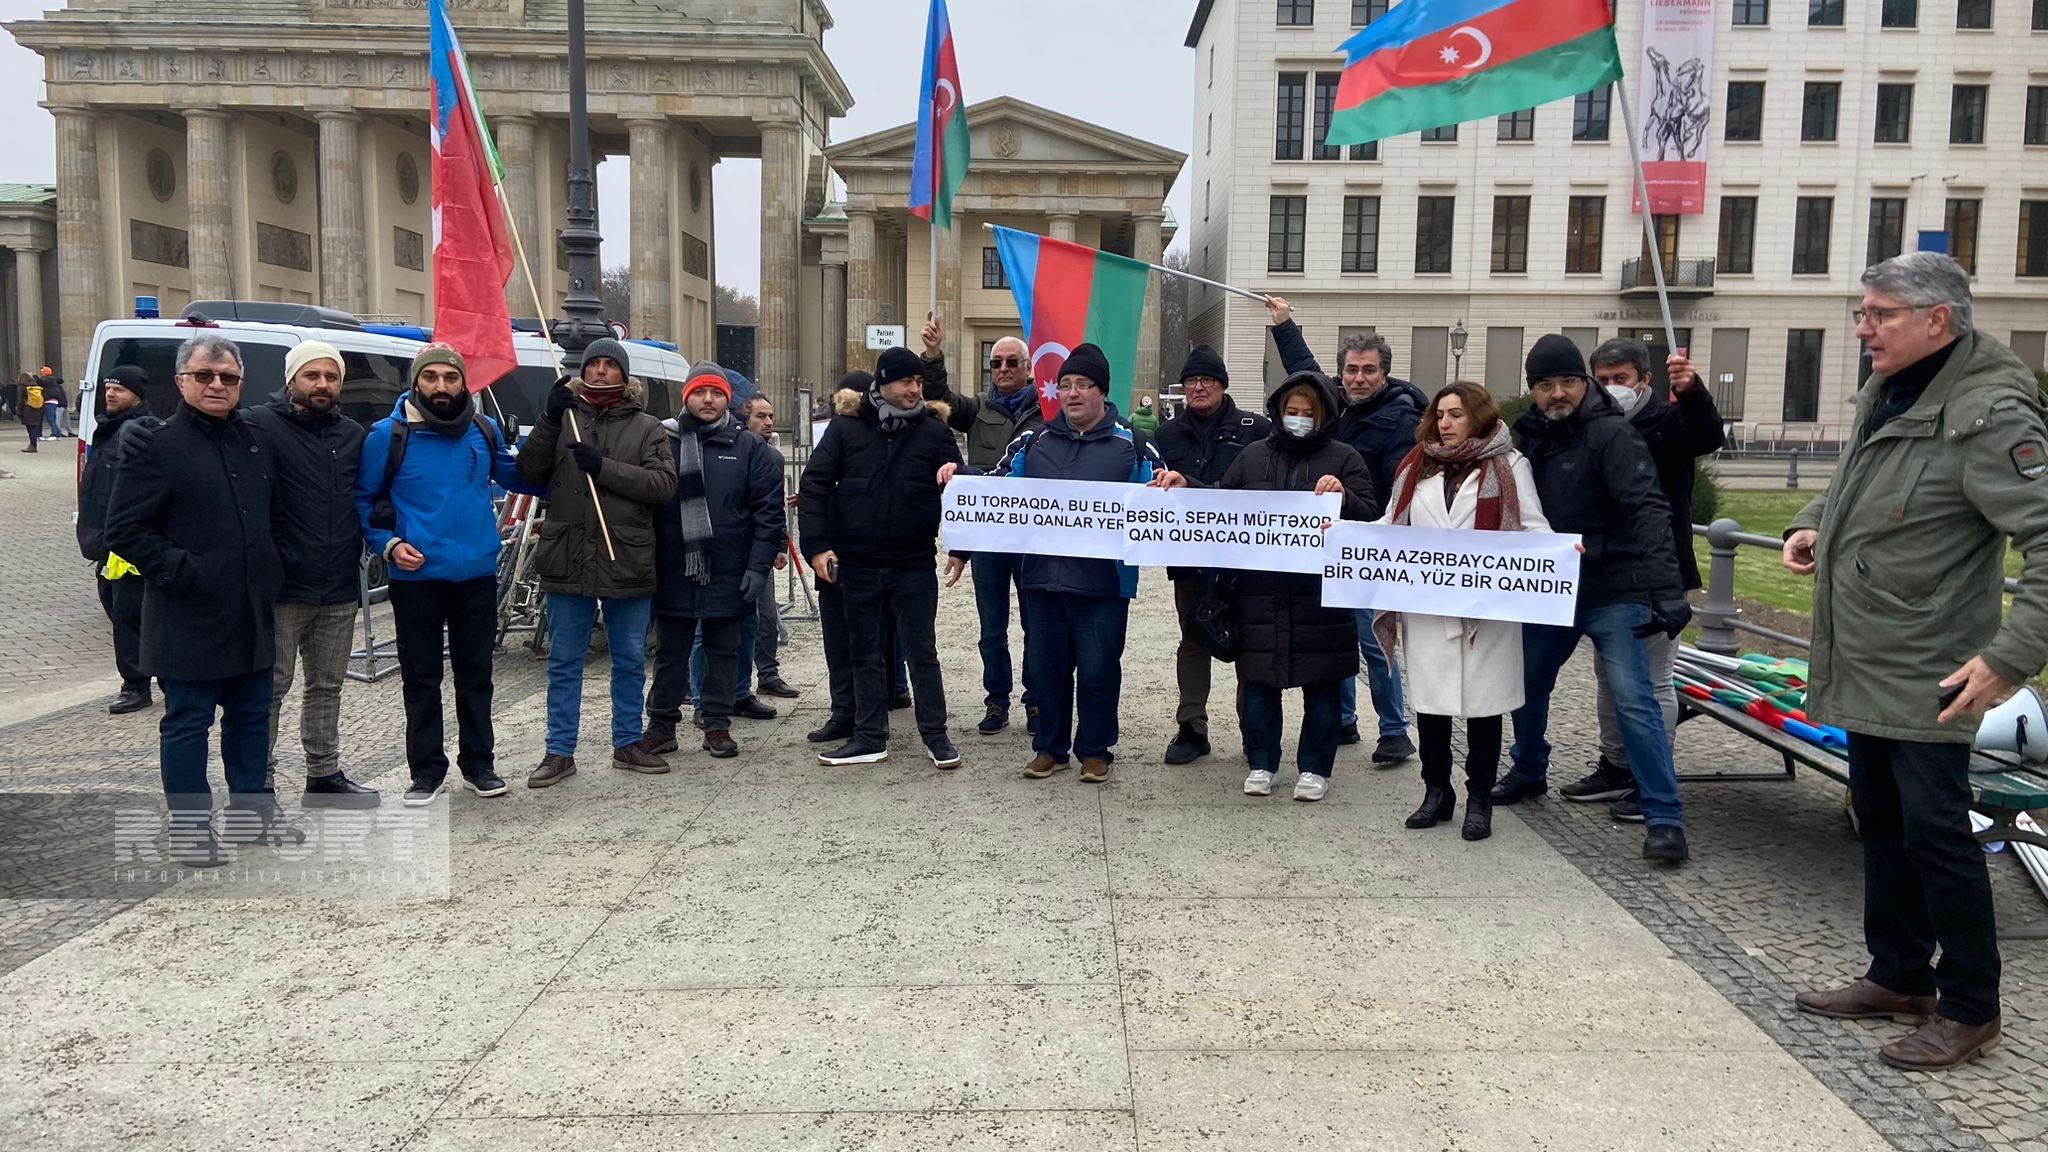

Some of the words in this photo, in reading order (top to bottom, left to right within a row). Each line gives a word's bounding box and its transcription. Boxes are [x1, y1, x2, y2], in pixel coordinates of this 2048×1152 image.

[957, 494, 977, 506] BU
[981, 495, 1064, 512] TORPAQDA,
[1068, 499, 1088, 512] BU
[1093, 501, 1124, 513] ELD
[944, 510, 1005, 523] QALMAZ
[1009, 513, 1029, 525] BU
[1033, 514, 1093, 529] QANLAR
[1126, 508, 1180, 526] BƏSİC,
[1185, 510, 1238, 525] SEPAH
[1129, 528, 1164, 543] QAN
[1169, 529, 1250, 545] QUSACAQ
[1341, 547, 1392, 562] BURA
[1396, 549, 1555, 573] AZƏRBAYCANDIR
[1324, 562, 1353, 579] BİR
[1358, 566, 1414, 585] QANA,
[1420, 567, 1456, 587] YÜZ
[1461, 570, 1492, 589] BİR
[1498, 576, 1573, 595] QANDIR
